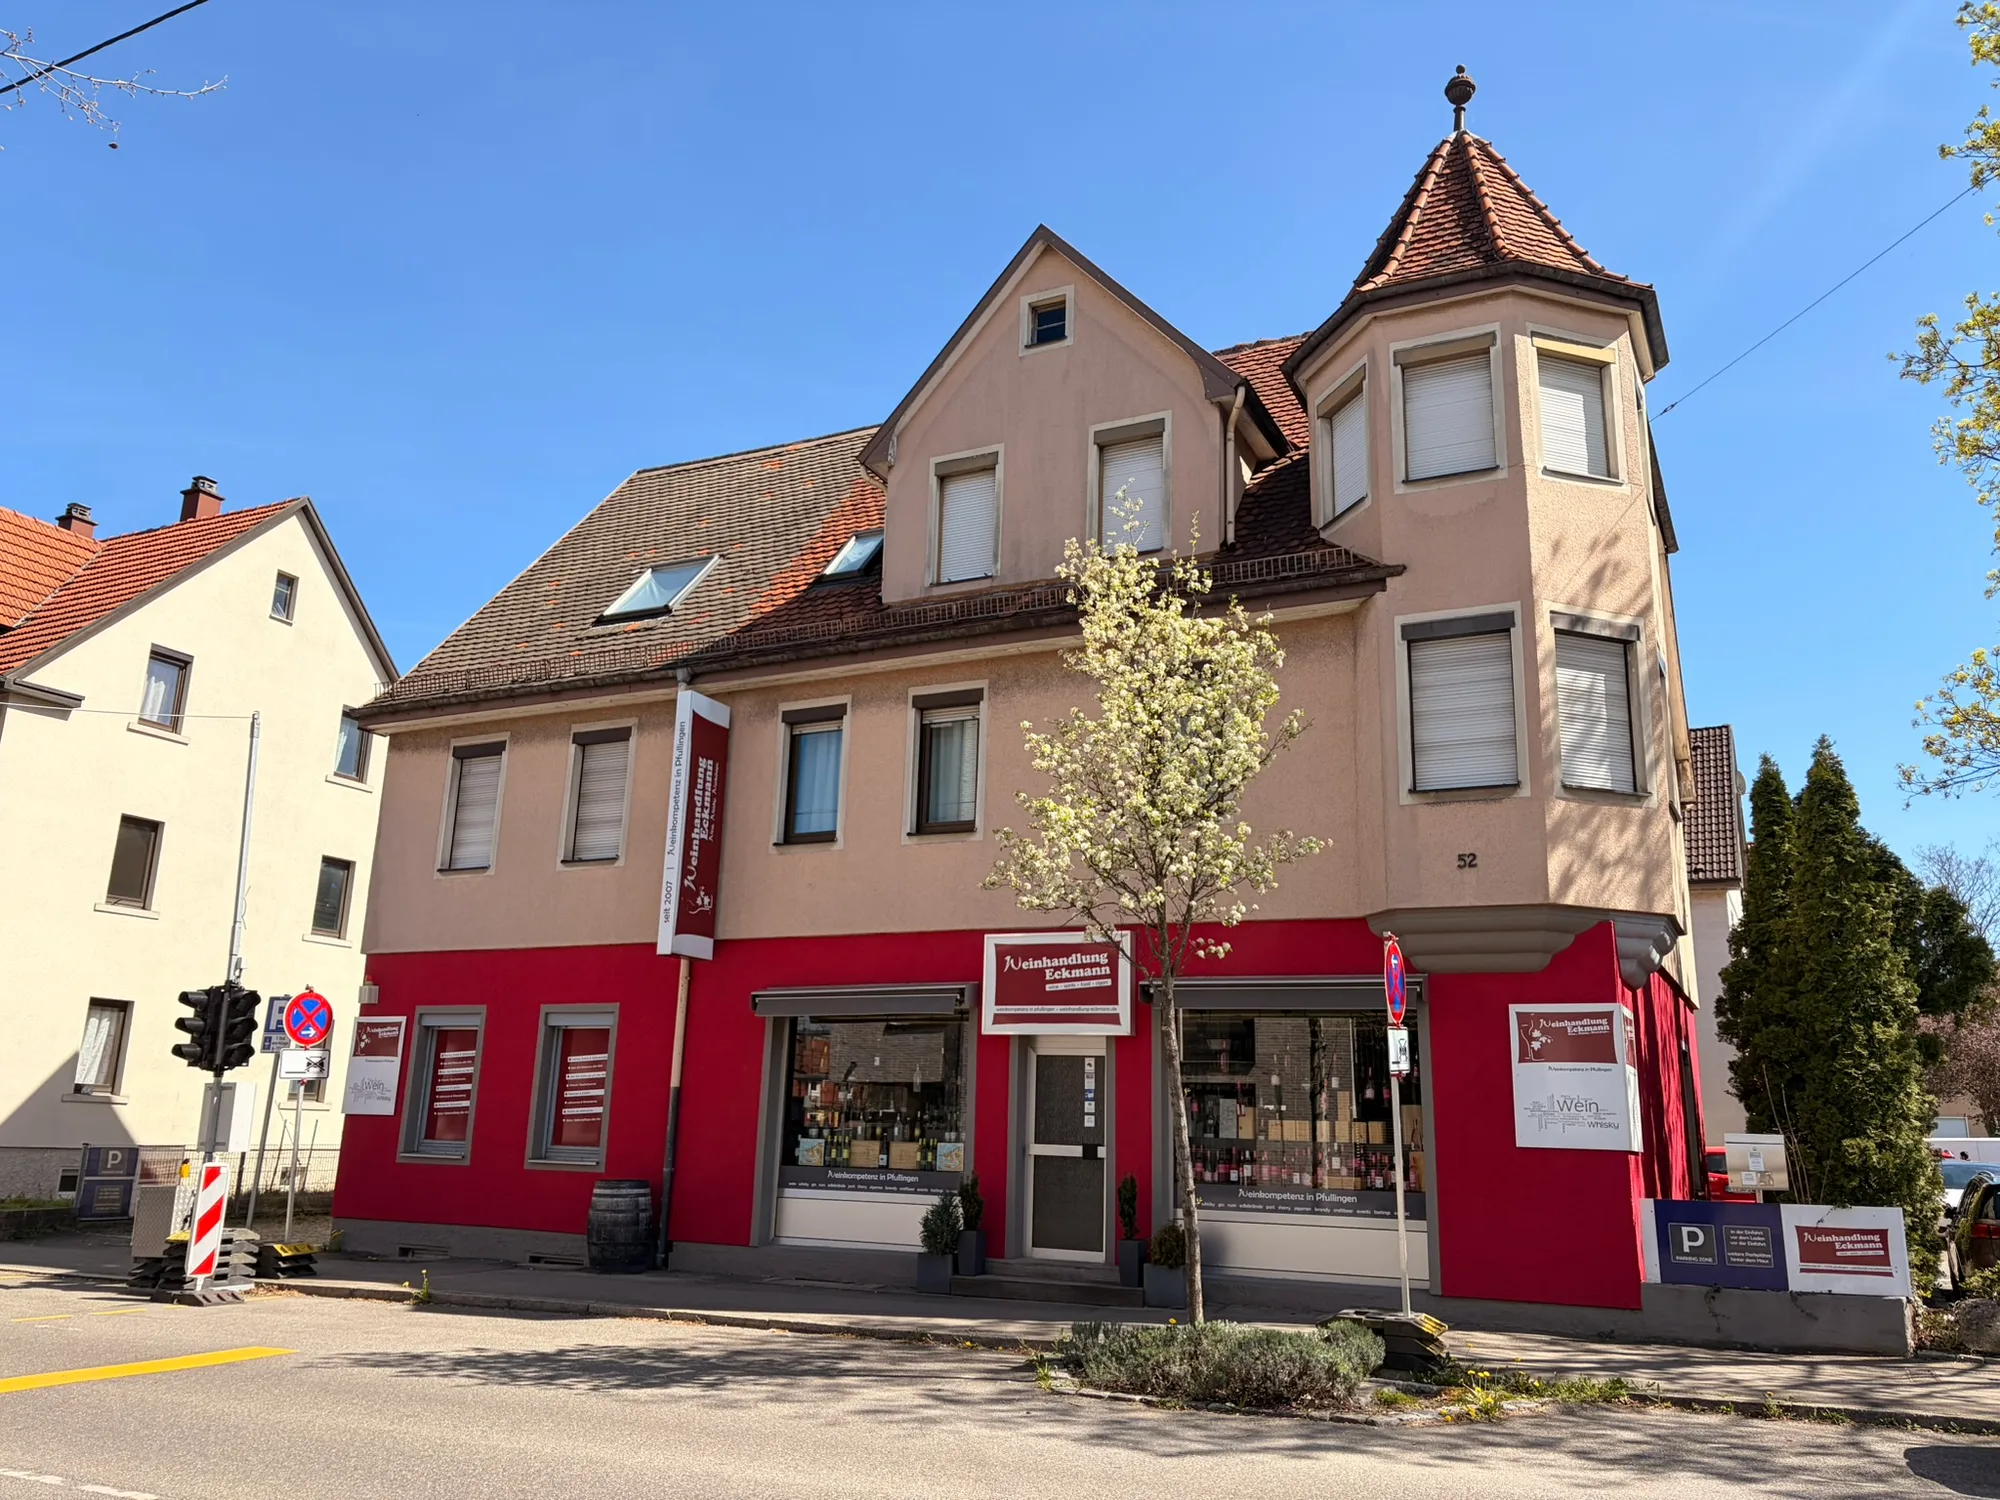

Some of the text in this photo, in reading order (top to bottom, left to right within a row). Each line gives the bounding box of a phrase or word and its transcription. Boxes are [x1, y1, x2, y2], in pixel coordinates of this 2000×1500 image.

[667, 722, 686, 856] Weinkompetenz in Pfullingen
[700, 759, 714, 840] Eckmann
[684, 756, 706, 891] Weinhandlung
[1457, 853, 1478, 869] 52
[663, 881, 673, 924] seit 2007
[1004, 952, 1108, 972] Weinhandlung
[1044, 966, 1110, 980] Eckmann
[1540, 1018, 1608, 1028] Weinhandlung
[1567, 1025, 1610, 1033] Eckmann
[364, 1082, 384, 1090] Wein
[1557, 1100, 1599, 1112] Wein
[1587, 1121, 1619, 1130] Whisky
[106, 1150, 122, 1169] P
[828, 1170, 878, 1180] Weinkompetenz
[887, 1173, 918, 1182] Pfullingen
[1238, 1189, 1304, 1200] Weinkompetenz
[1316, 1193, 1357, 1203] Pfullingen
[1681, 1226, 1704, 1252] P
[1804, 1232, 1880, 1242] Weinhandlung
